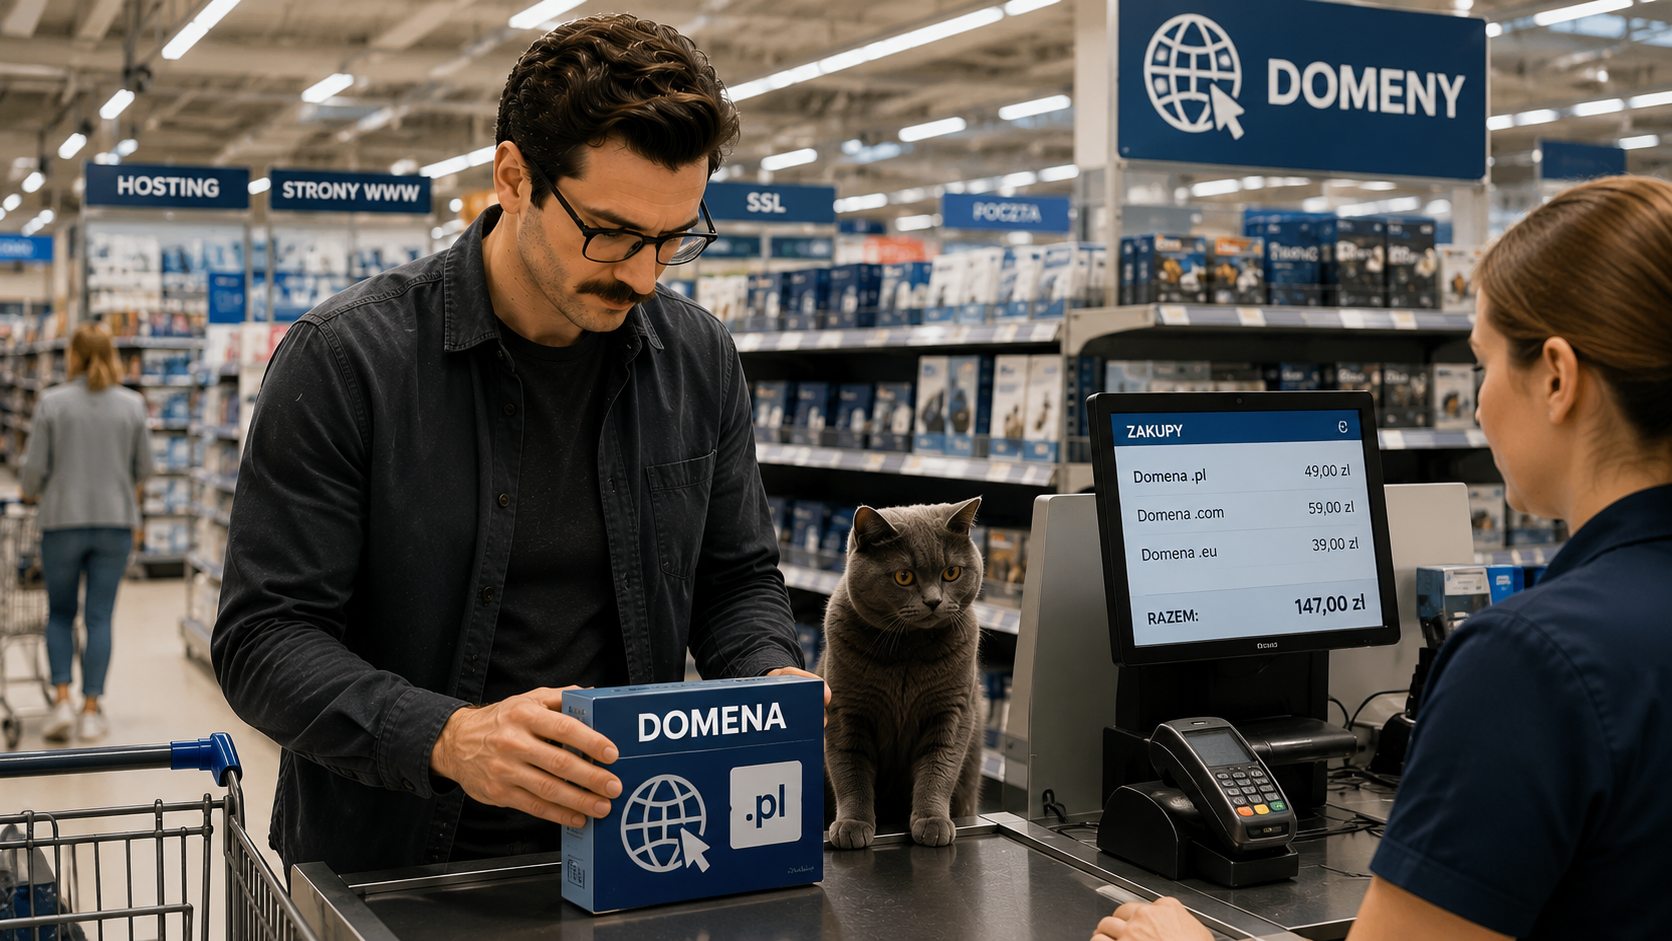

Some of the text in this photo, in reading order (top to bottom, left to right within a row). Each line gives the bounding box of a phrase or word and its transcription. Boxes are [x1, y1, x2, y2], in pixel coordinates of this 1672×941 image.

[1268, 58, 1466, 118] DOMENY
[117, 175, 220, 198] HOSTING
[282, 180, 420, 202] STRONY WWW
[746, 192, 786, 213] SSL
[973, 202, 1042, 223] POCZTA
[1126, 424, 1183, 439] ZAKUPY
[1133, 467, 1207, 485] Domena .pl
[1304, 464, 1338, 480] 49,00
[1137, 508, 1225, 523] Domena .com
[1308, 500, 1342, 516] 59,00
[1141, 547, 1218, 562] Domena .eu
[1311, 537, 1346, 553] 39,00
[1294, 592, 1366, 616] 147,00 zł
[1147, 608, 1199, 626] RAZEM:
[638, 702, 788, 743] DOMENA
[745, 783, 786, 829] .pl
